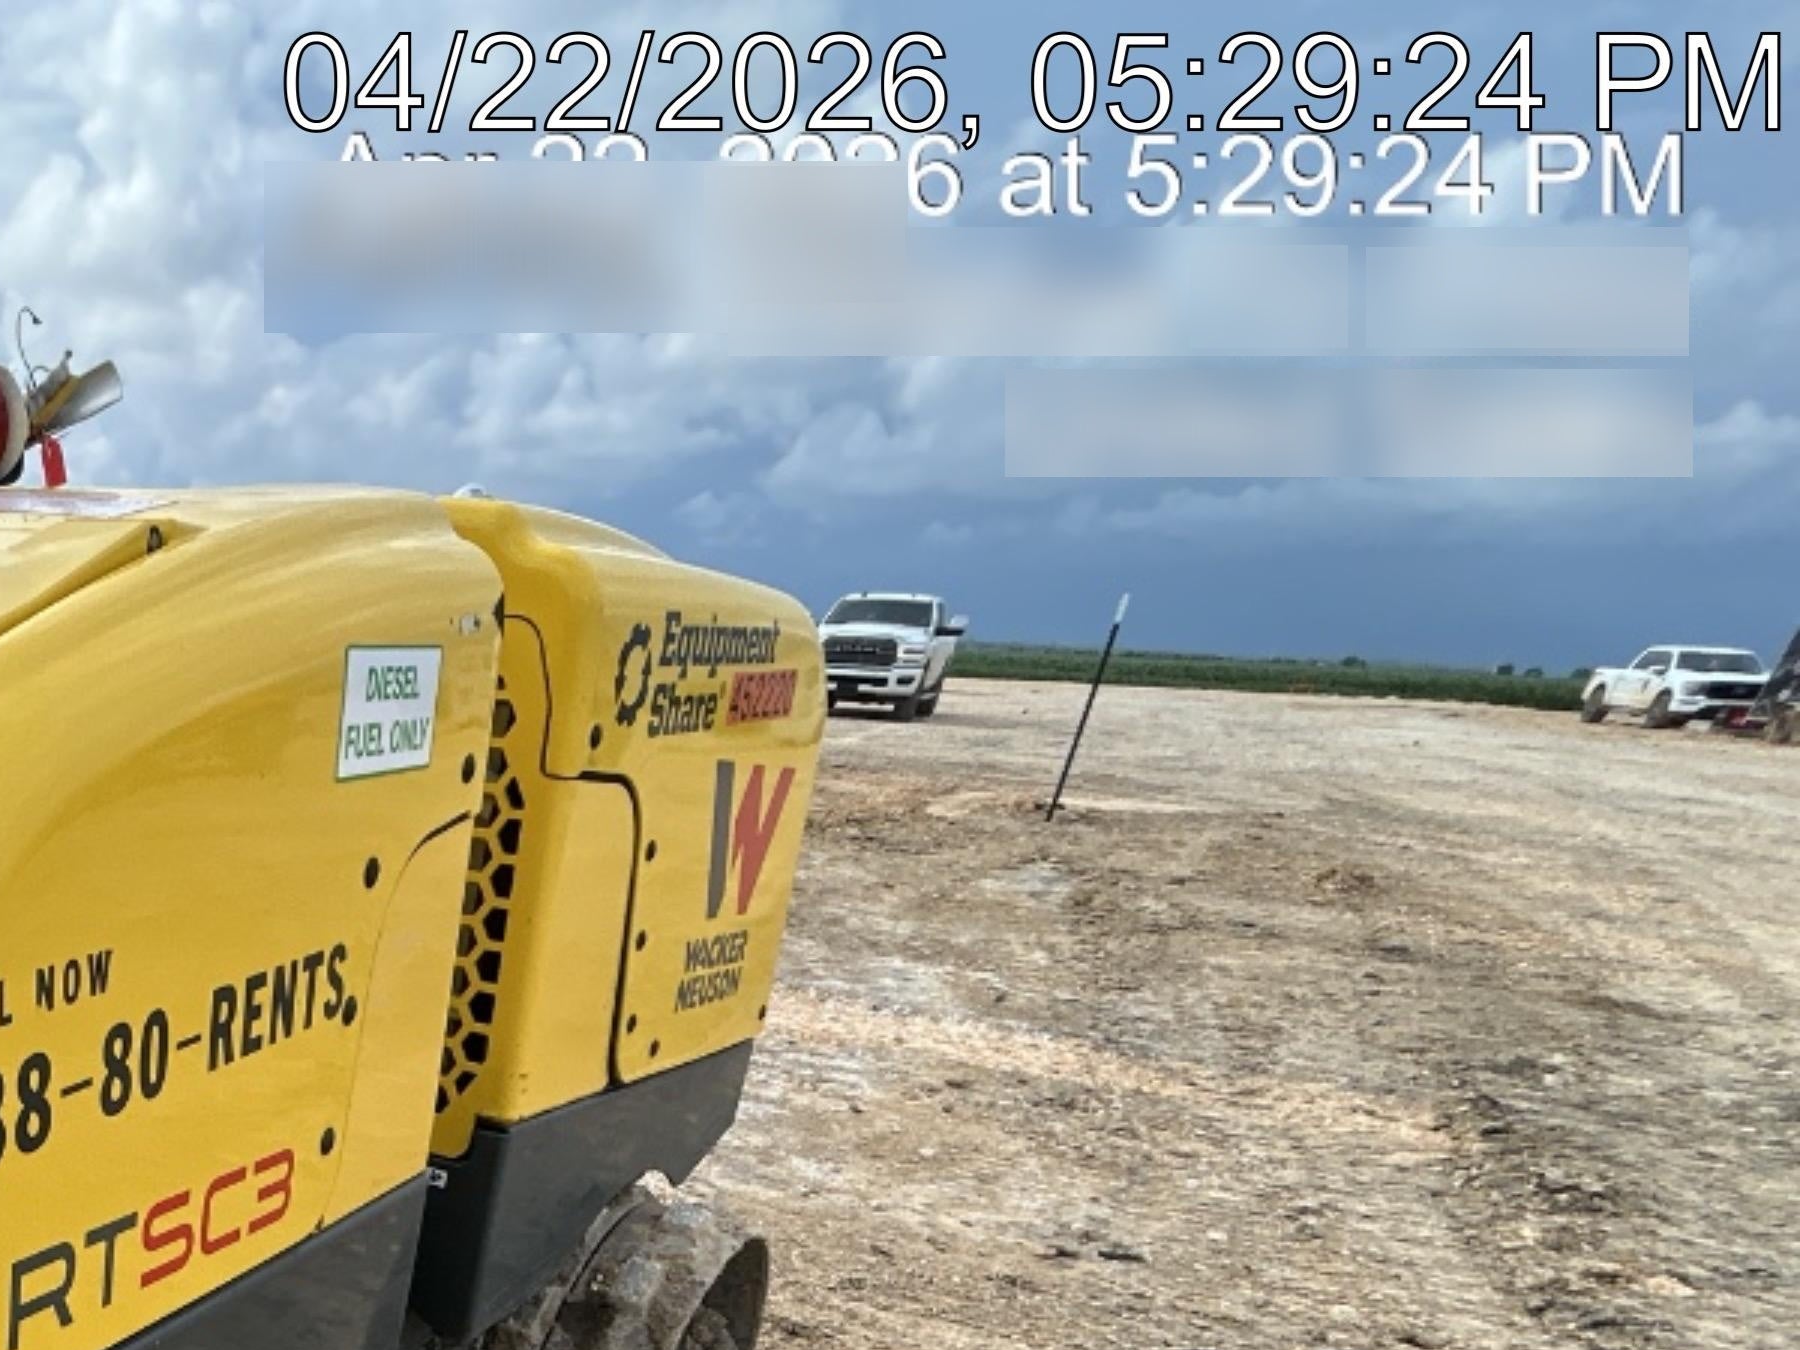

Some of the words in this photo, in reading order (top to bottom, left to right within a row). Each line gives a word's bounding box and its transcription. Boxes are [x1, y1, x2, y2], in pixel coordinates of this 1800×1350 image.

[658, 611, 781, 680] Equipment
[366, 665, 420, 702] DIESEL
[648, 682, 718, 738] Share
[344, 722, 385, 760] FUEL
[390, 716, 430, 753] ONLY
[683, 929, 748, 974] WACKER
[35, 949, 114, 1012] NOW
